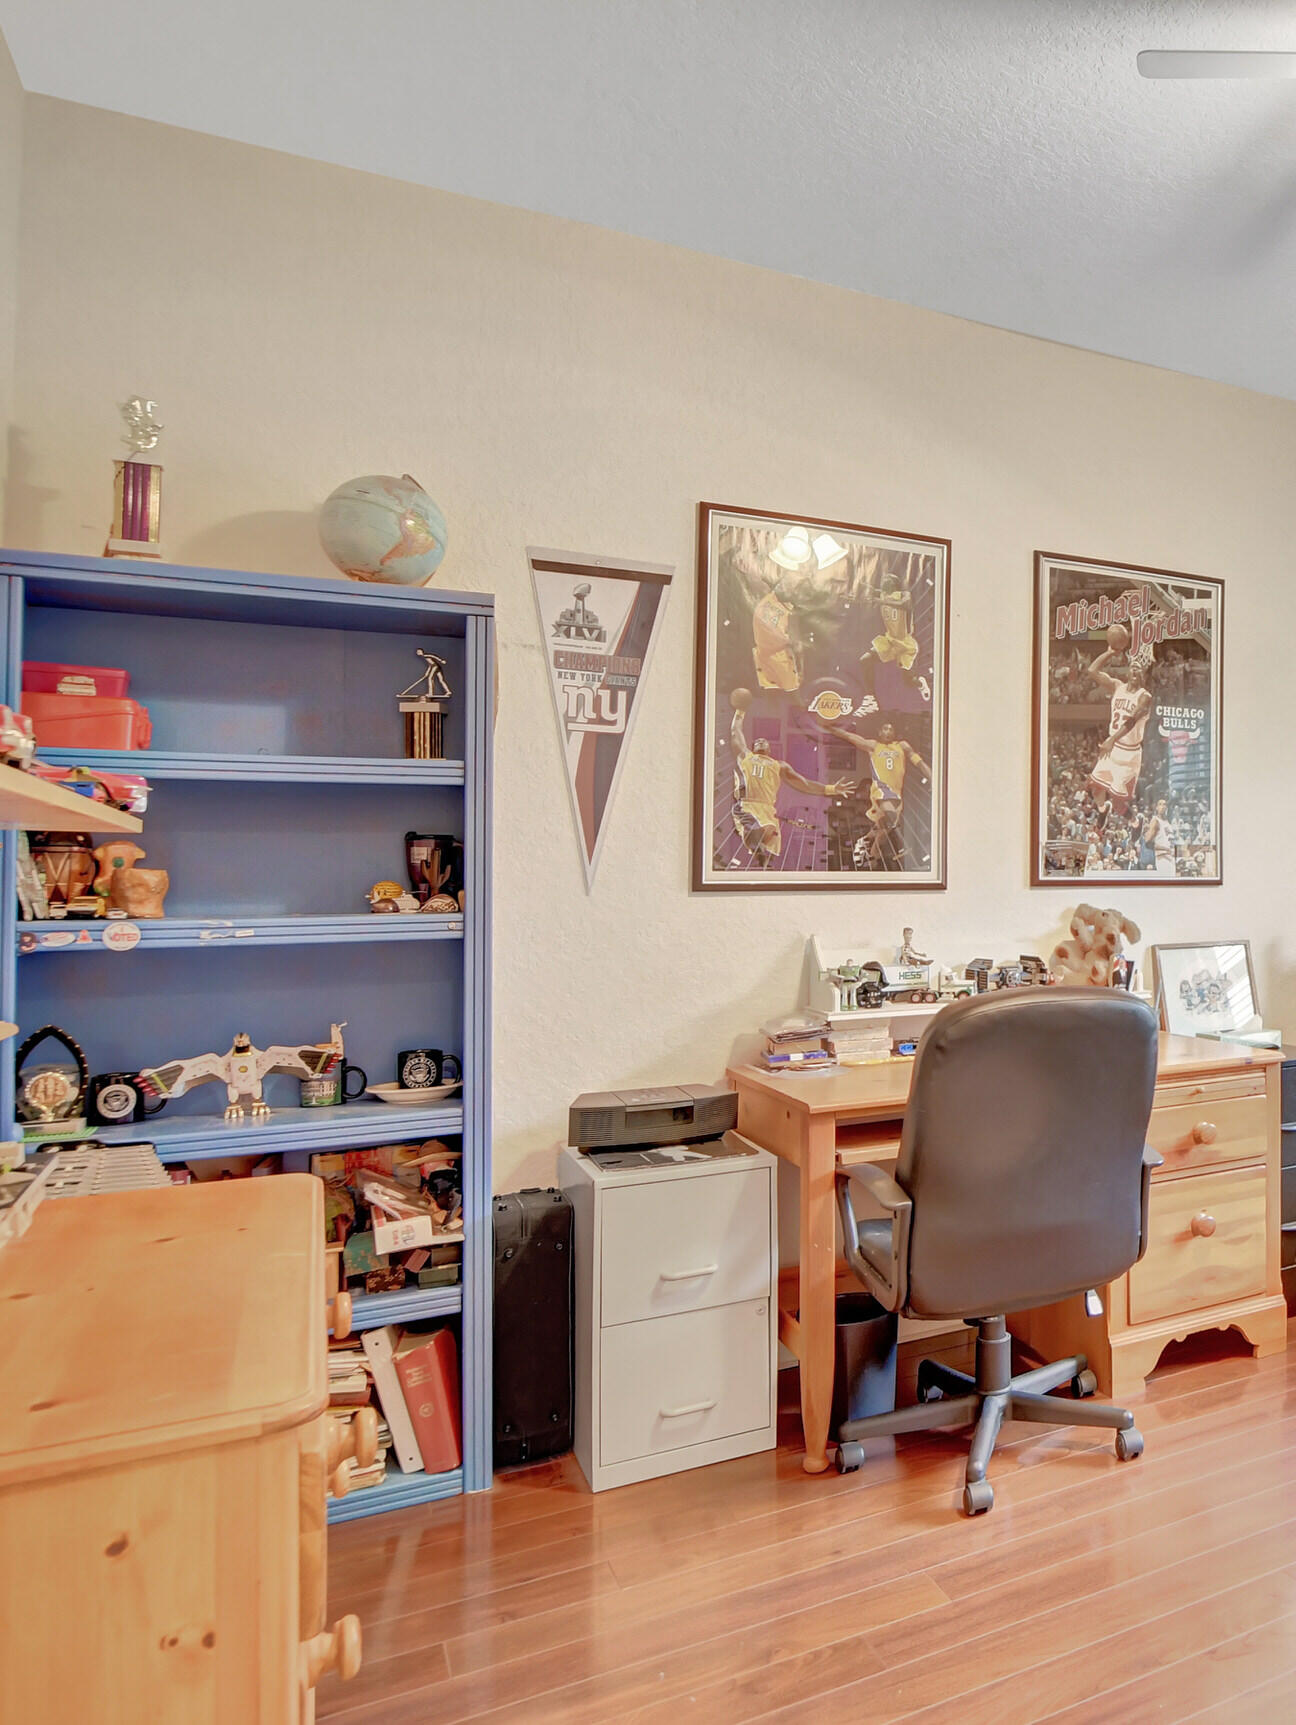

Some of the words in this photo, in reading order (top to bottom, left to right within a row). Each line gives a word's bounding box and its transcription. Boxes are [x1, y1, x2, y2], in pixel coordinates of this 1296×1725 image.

[1056, 584, 1150, 639] Michael
[552, 624, 607, 643] XLVI
[1129, 607, 1208, 657] Jordan
[553, 650, 641, 676] CHAMPIONS
[557, 671, 577, 681] NEW
[580, 673, 602, 683] YORK
[808, 695, 853, 715] LAKERS
[1156, 705, 1204, 720] CHICAGO
[1163, 717, 1197, 730] BULLS
[886, 757, 894, 770] 8
[899, 970, 921, 980] HESS
